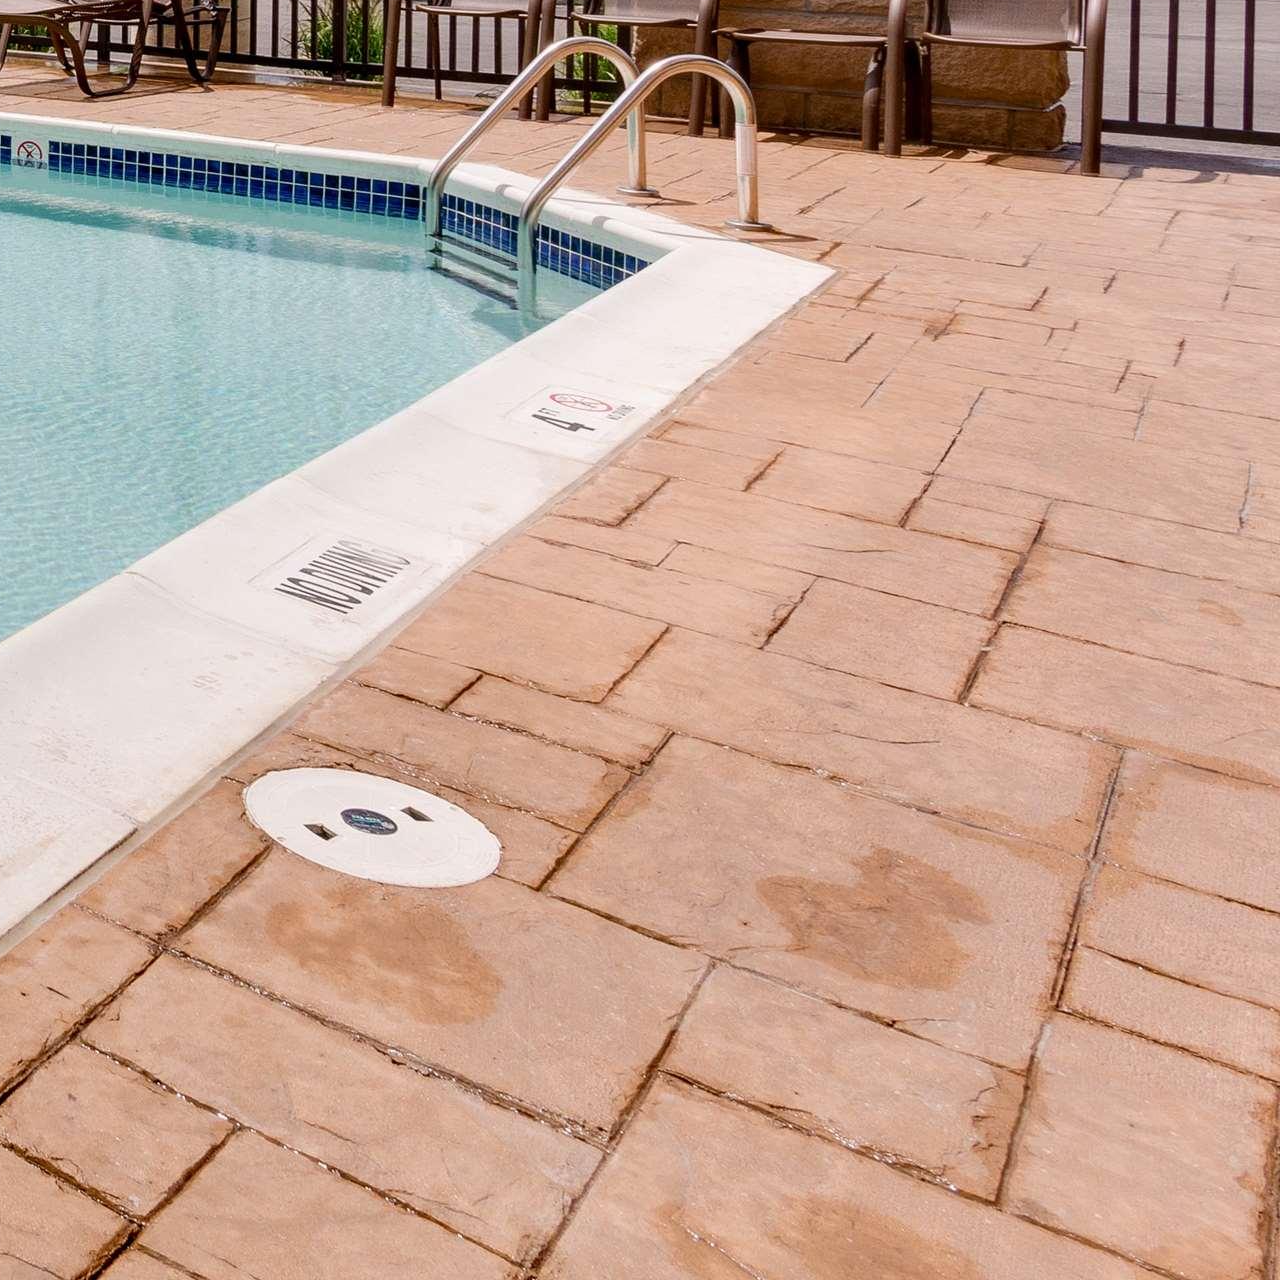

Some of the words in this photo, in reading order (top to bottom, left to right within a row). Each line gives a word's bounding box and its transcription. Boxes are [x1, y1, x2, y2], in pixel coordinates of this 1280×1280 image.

[531, 414, 596, 432] 4
[299, 539, 411, 596] DIVING
[274, 576, 362, 615] NO
